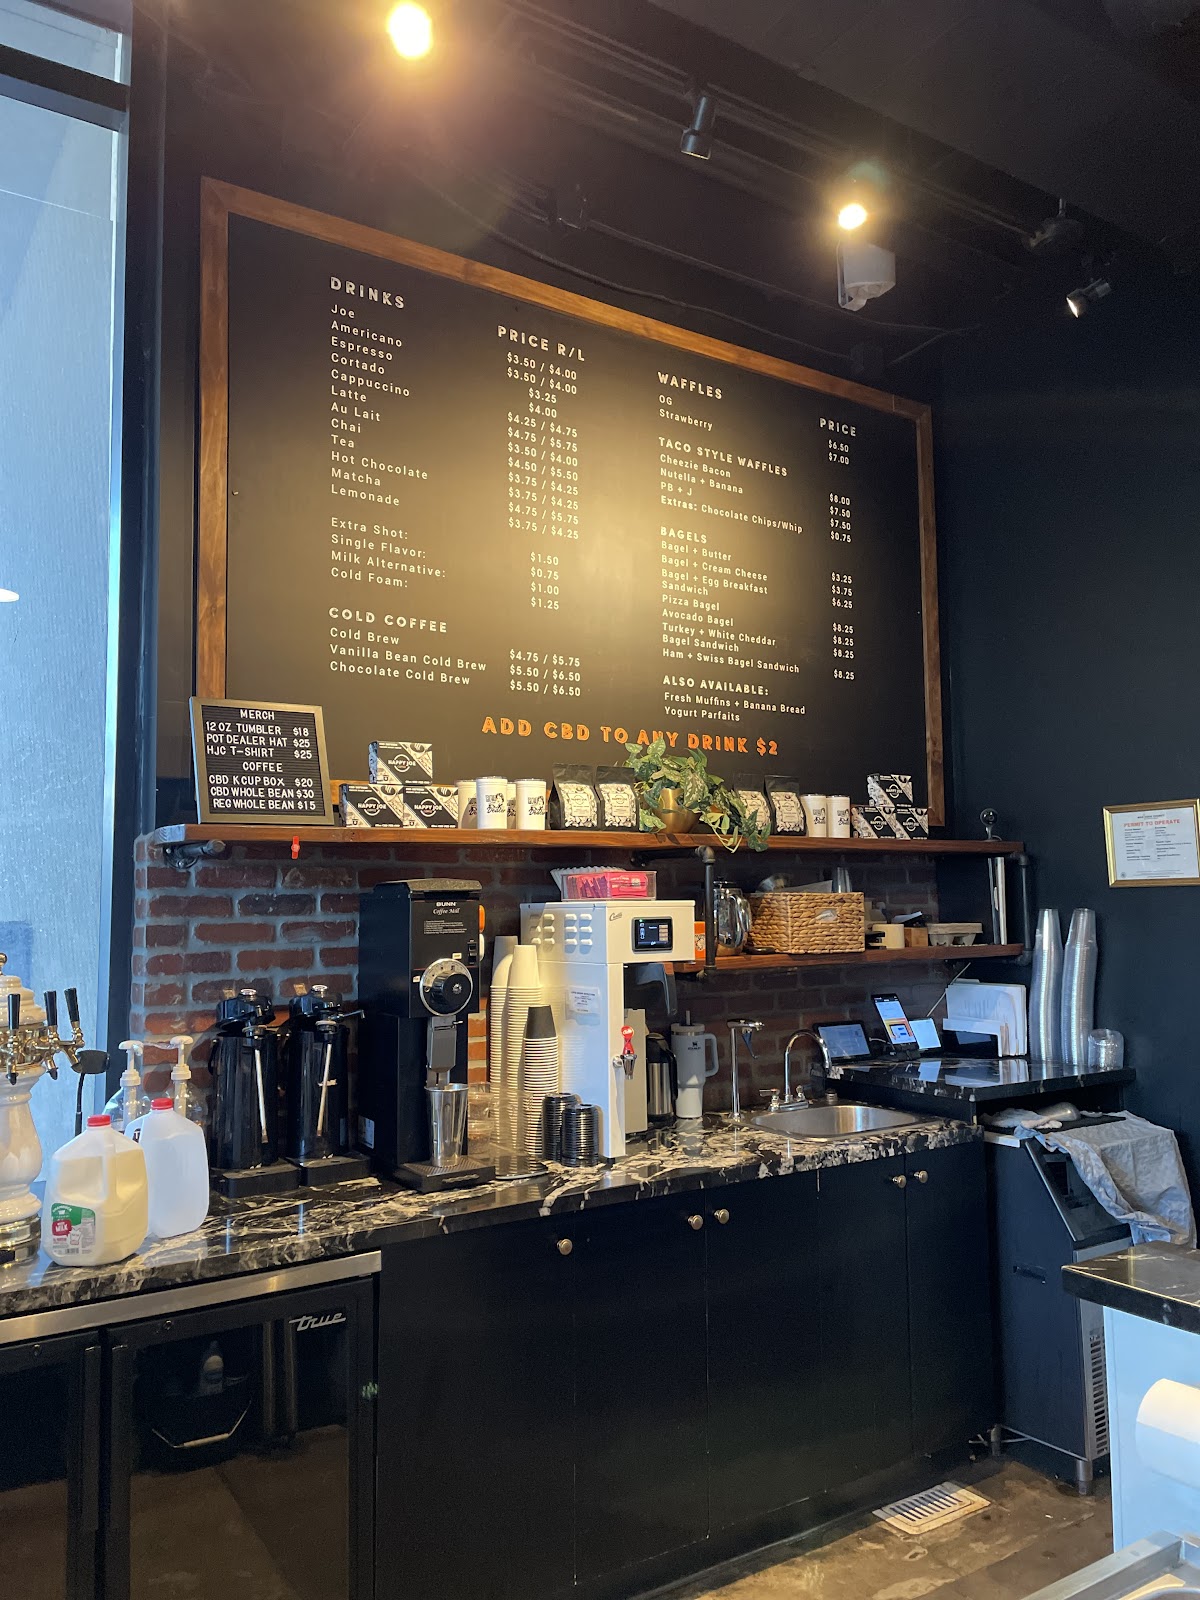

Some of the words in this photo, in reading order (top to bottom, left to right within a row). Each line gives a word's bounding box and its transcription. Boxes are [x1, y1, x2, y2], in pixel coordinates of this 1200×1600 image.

[331, 277, 404, 309] DRINKS
[331, 305, 355, 318] Joe
[332, 321, 402, 347] Americano
[498, 326, 549, 351] PRICE
[558, 343, 584, 361] R/L
[332, 337, 392, 361] Espresso
[332, 353, 385, 374] Cortado
[507, 352, 535, 368] $3.50
[540, 363, 544, 371] /
[549, 364, 576, 380] $4.00
[332, 370, 410, 397] Cappuccino
[658, 372, 722, 400] WAFFLES
[332, 385, 366, 402] Latte
[529, 388, 556, 403] $3.25
[659, 395, 672, 405] OG
[332, 403, 347, 414] Au
[355, 407, 380, 422] Lait
[529, 403, 557, 418] $4.00
[660, 409, 712, 431] Strawberry
[332, 419, 361, 433] Chai
[820, 418, 856, 437] PRICE
[332, 435, 354, 448] Tea
[829, 440, 849, 452] $6.50
[332, 452, 354, 465] Hot
[362, 458, 427, 480] Chocolate
[659, 437, 691, 453] TACO
[697, 447, 732, 463] STYLE
[738, 457, 787, 476] WAFFLES
[660, 454, 698, 471] Cheezie
[703, 464, 731, 478] Bacon
[829, 452, 849, 464] $7.00
[332, 468, 380, 486] Matcha
[660, 468, 696, 483] Nutella
[710, 479, 743, 494] Banana
[332, 484, 399, 506] Lemonade
[661, 482, 673, 492] PB
[661, 495, 697, 510] Extras:
[702, 505, 748, 522] Chocolate
[752, 515, 802, 533] Chips/Whip
[332, 517, 366, 532] Extra
[374, 525, 407, 539] Shot:
[661, 526, 707, 543] BAGELS
[332, 534, 374, 550] Single
[381, 543, 425, 558] Flavor:
[662, 541, 688, 554] Bagel
[702, 549, 731, 561] Butter
[332, 551, 360, 564] Milk
[367, 557, 445, 577] Alternative:
[531, 552, 558, 565] $1.50
[662, 555, 688, 567] Bagel
[702, 562, 731, 575] Cream
[735, 568, 767, 581] Cheese
[332, 568, 361, 581] Cold
[369, 574, 407, 587] Foam:
[531, 567, 559, 580] $0.75
[662, 569, 689, 581] Bagel
[703, 576, 719, 588] Egg
[723, 579, 767, 594] Breakfast
[832, 573, 852, 584] $3.25
[531, 582, 559, 595] $1.00
[662, 581, 708, 596] Sandwich
[531, 597, 559, 610] $1.25
[662, 595, 689, 606] Pizza
[693, 600, 720, 611] Bagel
[329, 607, 375, 624] COLD
[385, 615, 446, 633] COFFEE
[663, 609, 703, 622] Avocado
[708, 615, 733, 627] Bagel
[330, 628, 360, 641] Cold
[368, 633, 399, 645] Brew
[663, 623, 695, 637] Turkey
[708, 629, 735, 641] White
[739, 633, 775, 646] Cheddar
[663, 635, 690, 646] Bagel
[694, 639, 739, 652] Sandwich
[330, 644, 378, 659] Vanilla
[386, 652, 416, 663] Bean
[423, 656, 451, 667] Cold
[457, 660, 486, 671] Brew
[663, 648, 683, 659] Ham
[697, 653, 724, 664] Swiss
[728, 657, 753, 668] Bagel
[757, 661, 799, 673] Sandwich
[330, 661, 399, 678] Chocolate
[406, 669, 434, 681] Cold
[441, 674, 470, 685] Brew
[663, 675, 694, 688] ALSO
[700, 680, 769, 695] AVAILABLE:
[665, 692, 691, 703] Fresh
[696, 696, 731, 707] Muffins
[744, 701, 777, 712] Banana
[781, 705, 805, 714] Bread
[240, 709, 274, 720] MERCH
[665, 706, 697, 717] Yogurt
[702, 710, 740, 721] Parfaits
[206, 722, 216, 731] 12
[219, 723, 232, 732] OZ
[236, 723, 281, 735] TUMBLER
[293, 727, 309, 736] $18
[482, 716, 532, 736] ADD
[544, 722, 590, 741] CBD
[601, 726, 628, 744] TO
[688, 733, 748, 753] DRINK
[756, 737, 778, 756] $2
[207, 734, 224, 743] POT
[227, 735, 265, 746] DEALER
[269, 738, 287, 747] HAT
[293, 739, 310, 748] $25
[207, 746, 226, 755] HJC
[230, 746, 274, 757] T-SHIRT
[294, 750, 312, 759] $25
[243, 762, 283, 772] COFFEE
[209, 775, 228, 784] CBD
[264, 777, 284, 786] BOX
[295, 778, 312, 787] $20
[211, 787, 229, 796] CBD
[231, 788, 264, 797] WHOLE
[268, 788, 294, 798] BEAN
[296, 790, 314, 798] $30
[214, 799, 231, 808] REG
[233, 799, 266, 809] WHOLE
[268, 800, 294, 809] BEAN
[298, 801, 316, 810] $15
